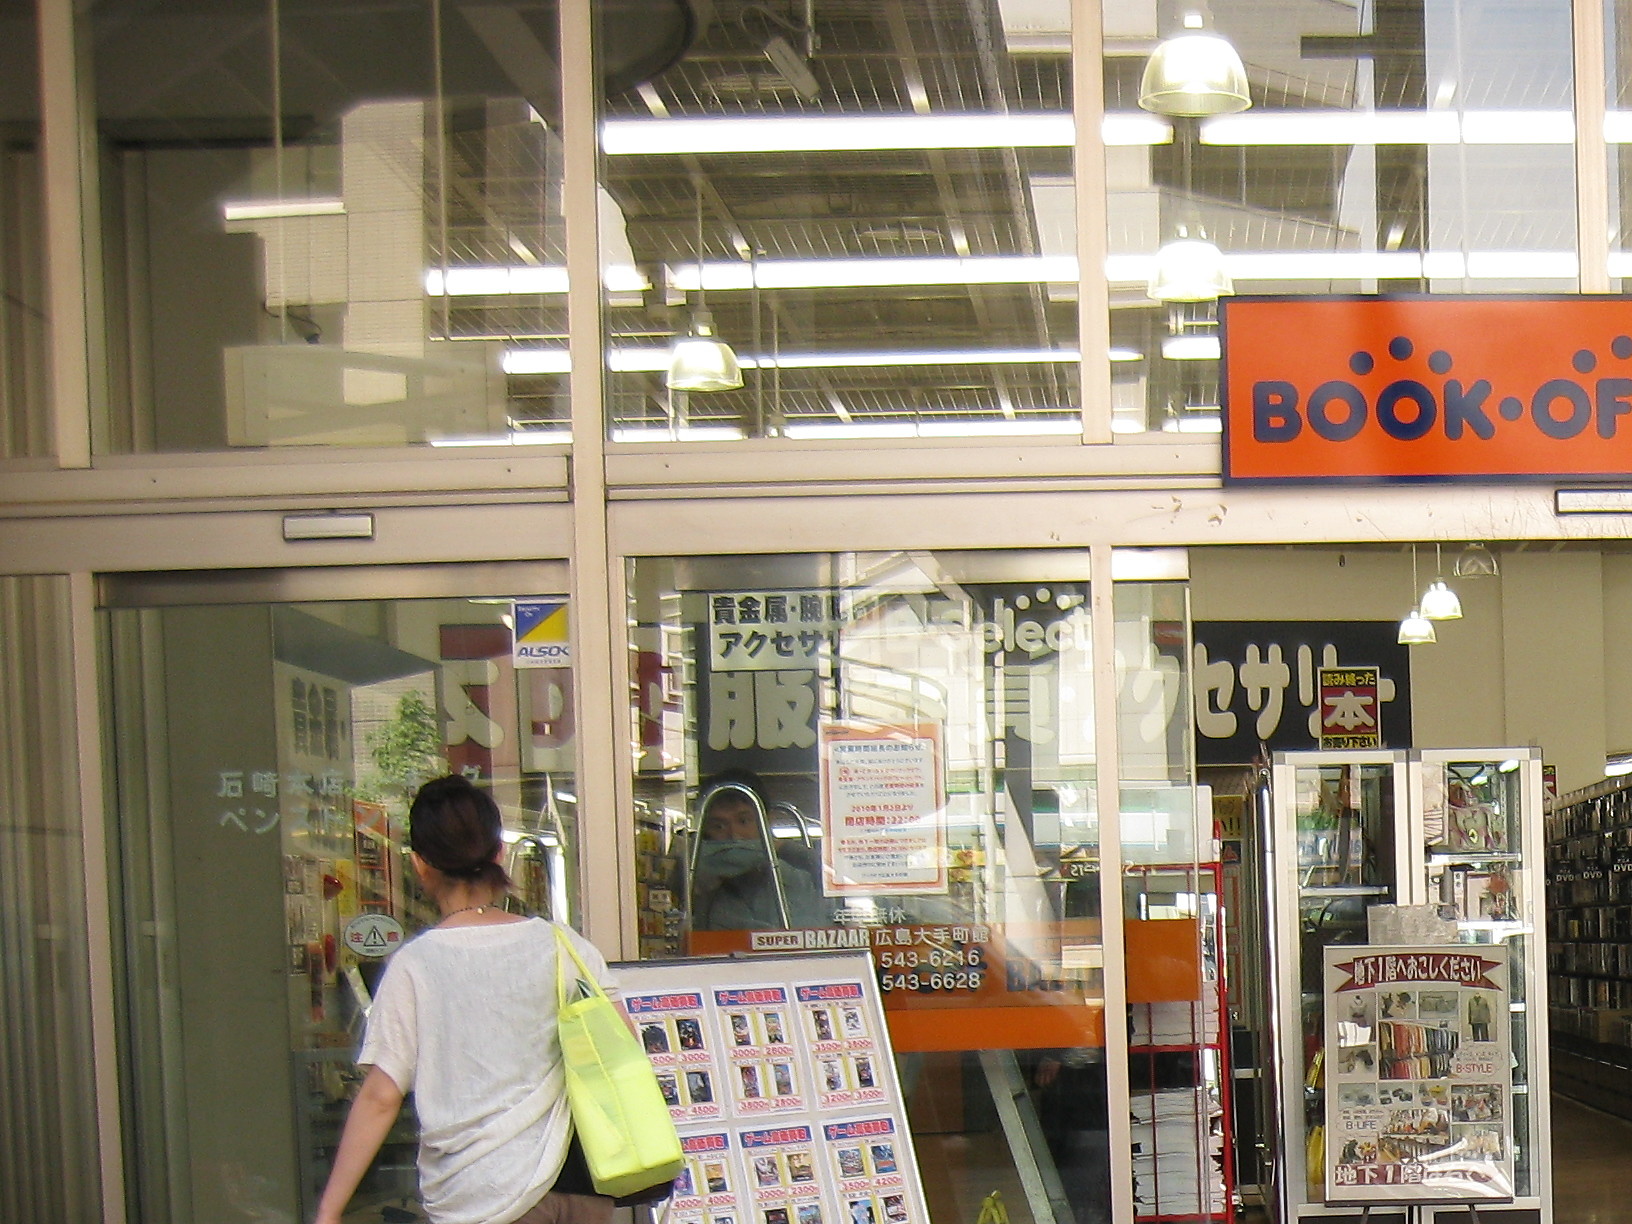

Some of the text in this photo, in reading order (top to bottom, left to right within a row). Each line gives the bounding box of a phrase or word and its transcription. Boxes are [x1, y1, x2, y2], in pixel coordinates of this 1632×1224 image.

[518, 646, 569, 657] ALSOK
[1323, 691, 1376, 732] 本
[1583, 871, 1602, 880] DVD
[757, 936, 798, 946] SUPER
[804, 929, 870, 948] BAZAAR
